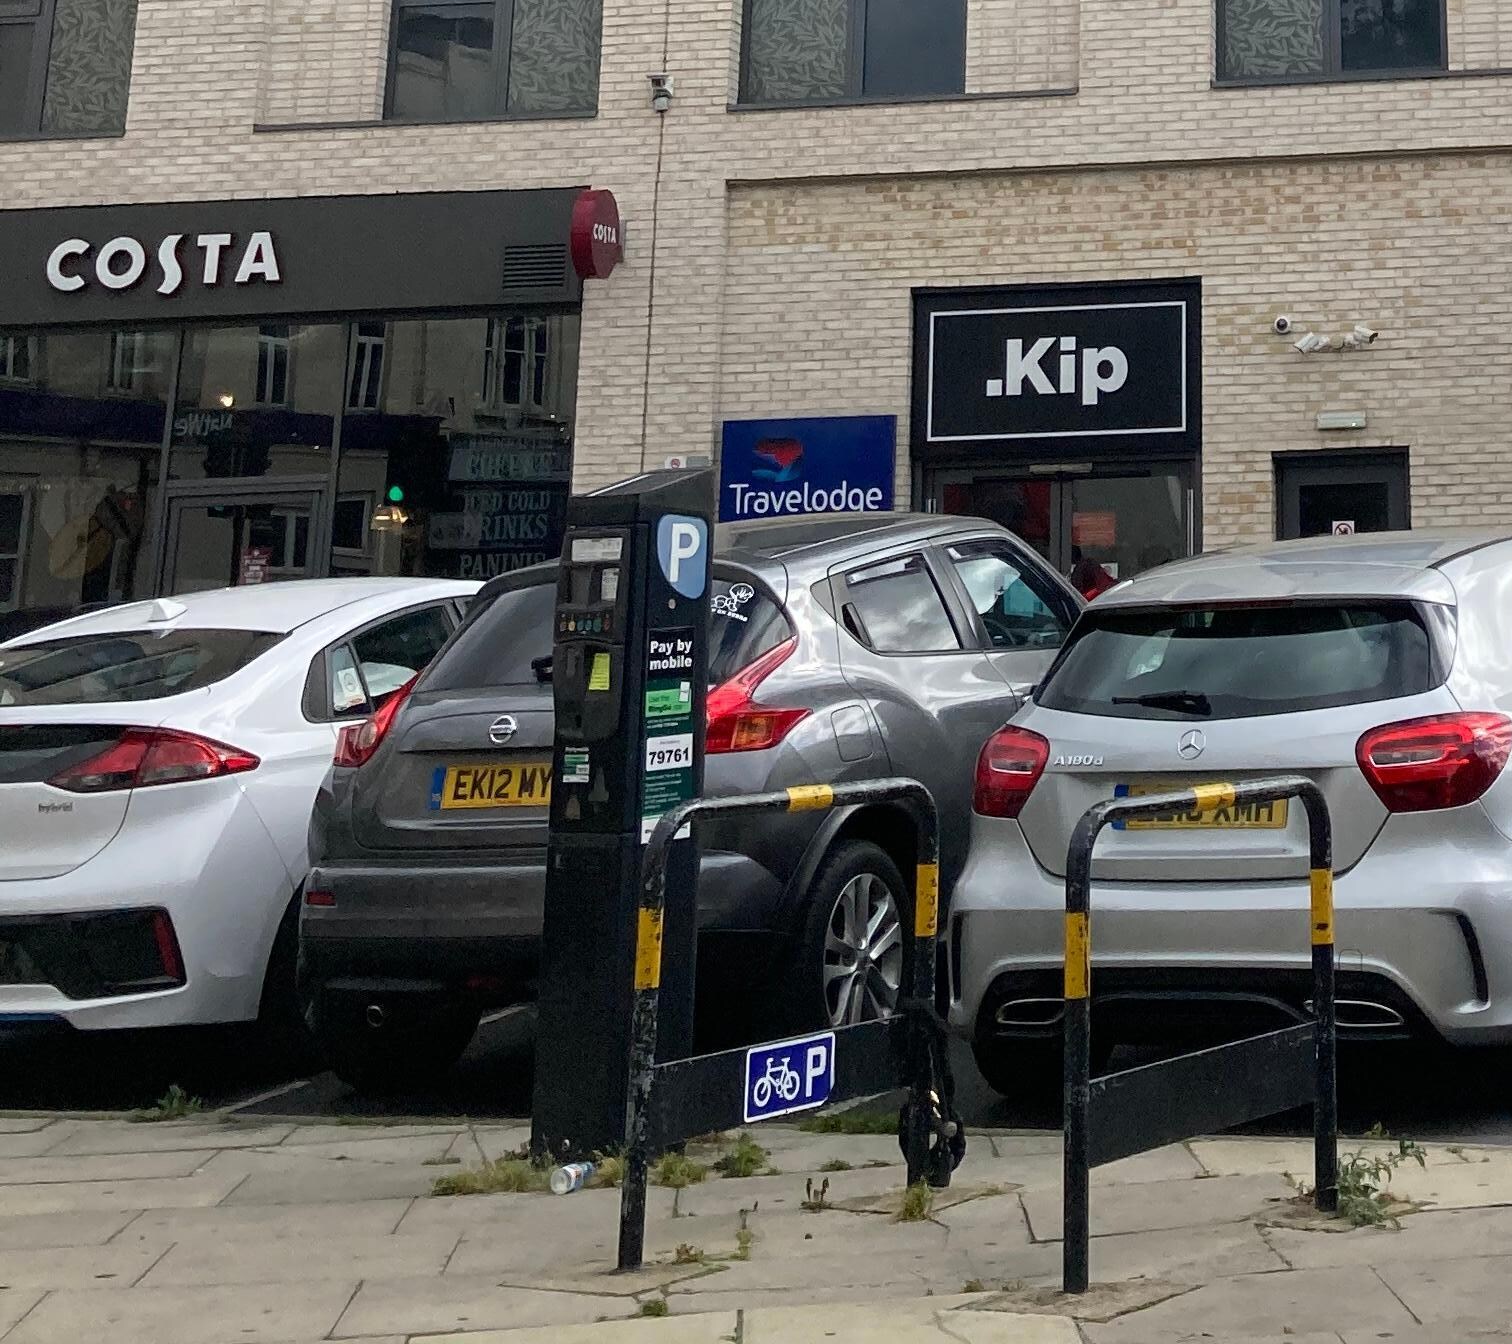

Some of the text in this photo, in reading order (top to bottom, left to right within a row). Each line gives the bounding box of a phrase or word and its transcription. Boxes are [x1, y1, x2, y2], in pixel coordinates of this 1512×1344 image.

[592, 223, 617, 244] COSTA
[46, 231, 281, 295] COSTA
[985, 335, 1129, 406] .Kip
[507, 489, 552, 512] COLD
[728, 480, 884, 515] Travelodge
[669, 522, 700, 583] P
[649, 638, 693, 656] Pay by
[649, 655, 693, 671] mobile
[648, 747, 689, 766] 79761
[452, 767, 554, 801] EK12 MY
[806, 1046, 827, 1097] P
